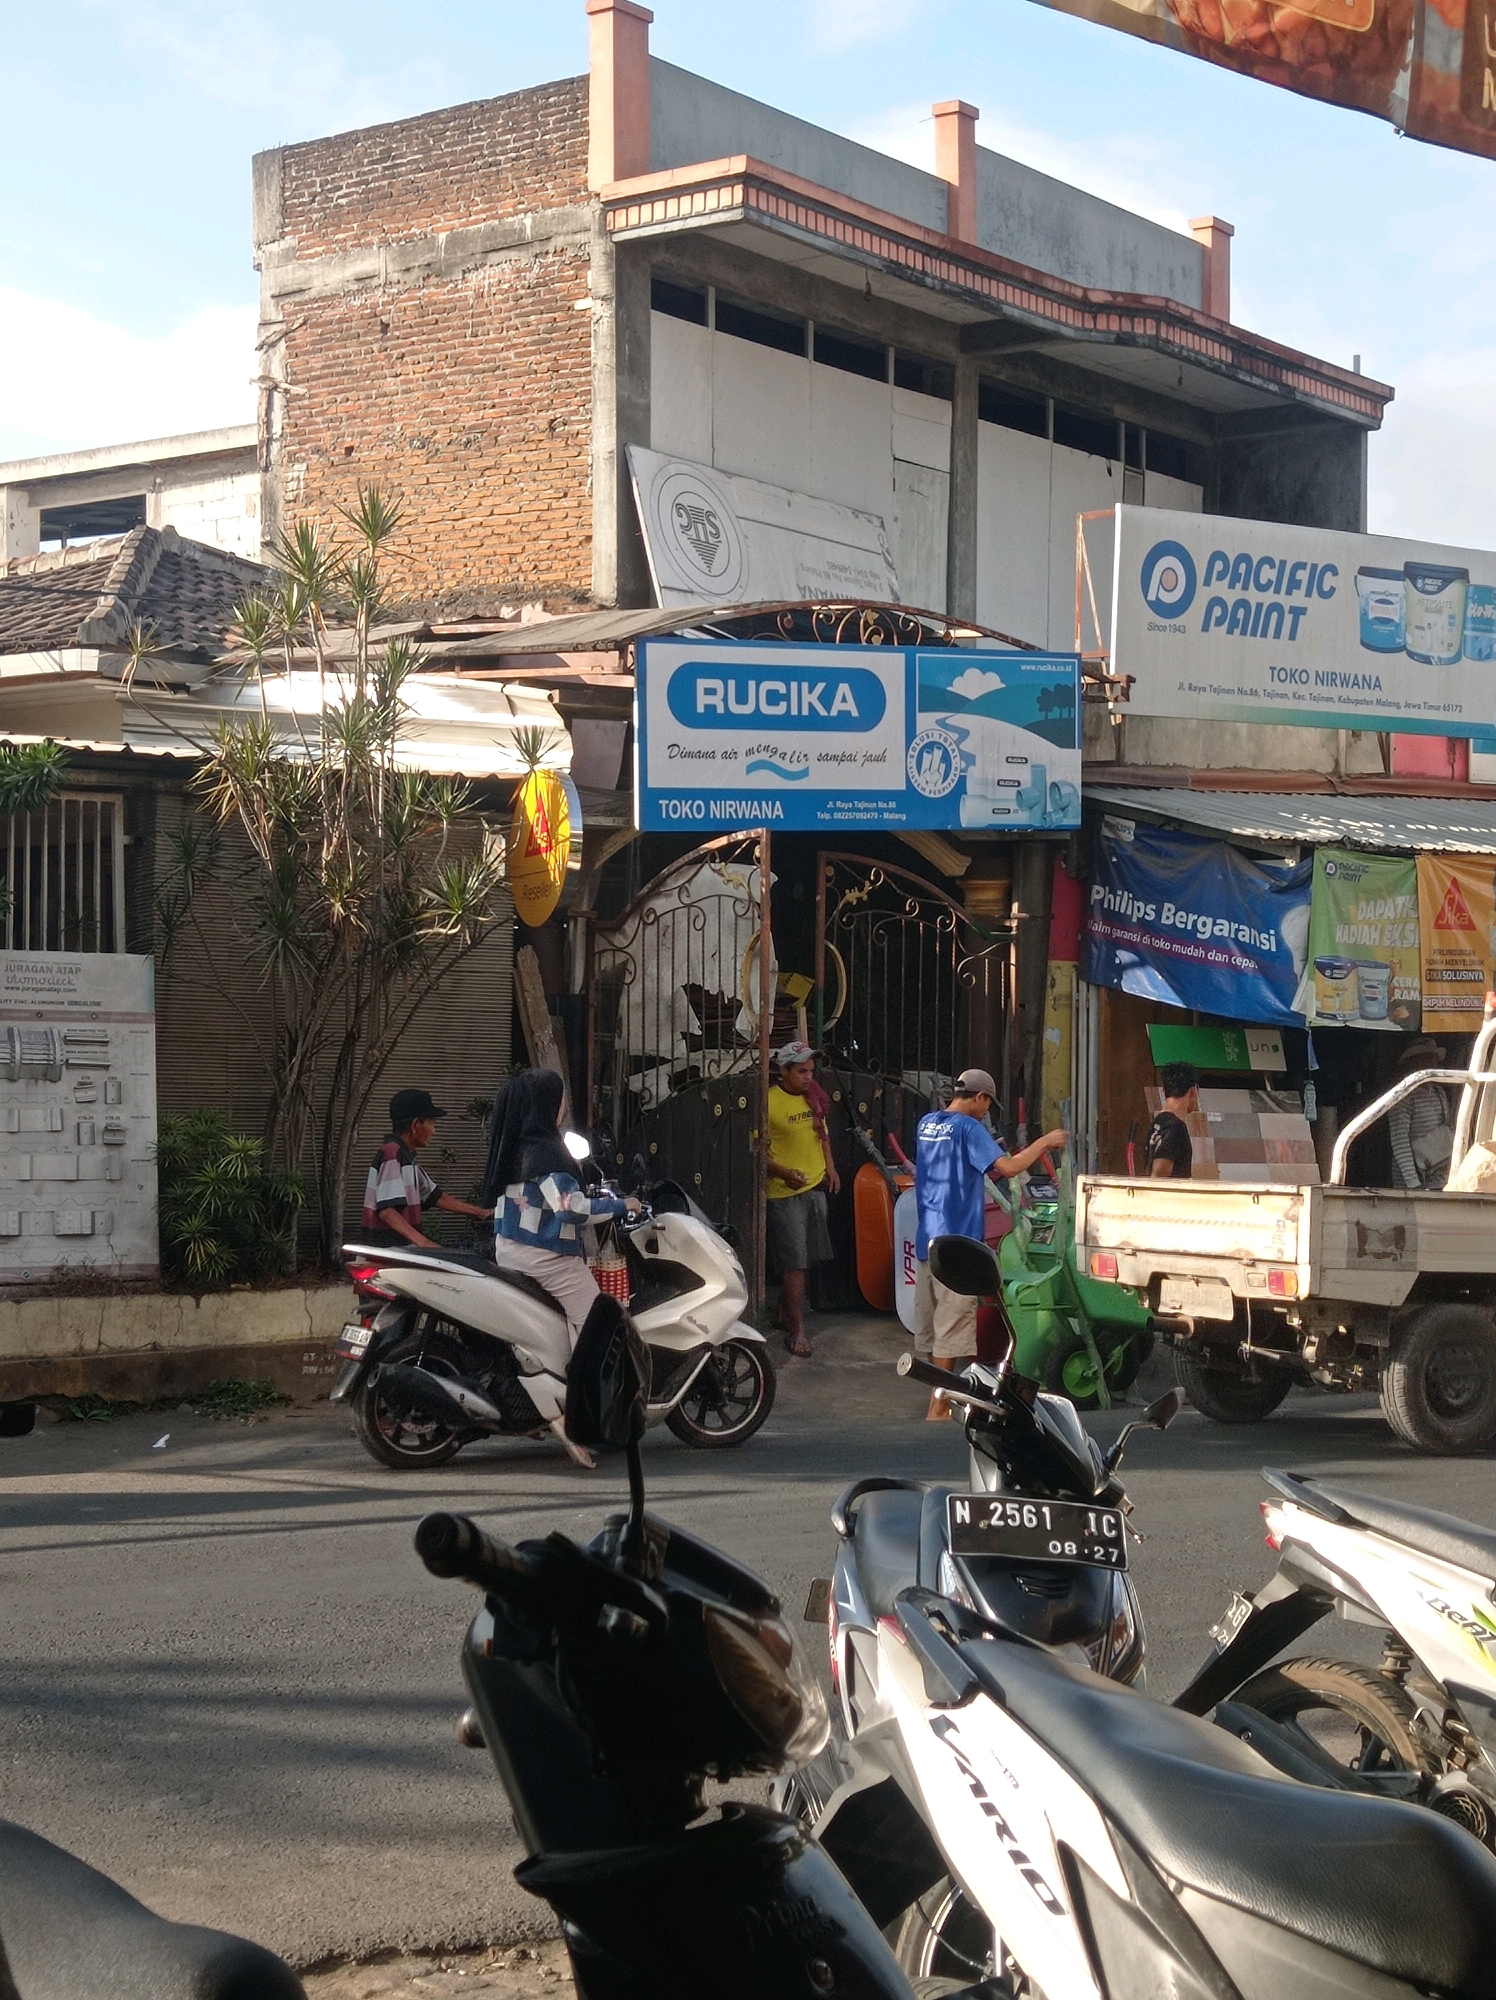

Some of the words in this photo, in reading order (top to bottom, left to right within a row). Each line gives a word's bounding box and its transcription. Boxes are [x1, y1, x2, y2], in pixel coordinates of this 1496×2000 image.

[1203, 550, 1339, 600] PACIFIC
[1147, 621, 1168, 633] Since
[1168, 623, 1186, 635] 1943
[1201, 598, 1308, 642] PAINT
[1020, 663, 1072, 672] www.rucika.co.id
[1268, 666, 1310, 685] TOKO
[1314, 670, 1383, 692] NIRWANA
[695, 677, 860, 718] RUCIKA
[1177, 682, 1186, 691] Jl.
[1188, 683, 1207, 694] Raya
[1209, 684, 1235, 695] Tajinan
[1403, 700, 1422, 711] Jawa
[1442, 703, 1463, 713] 65172
[667, 743, 717, 760] Dimana
[720, 749, 738, 760] air
[745, 743, 810, 764] mengalir
[816, 750, 858, 767] sampai
[861, 748, 888, 767] jauh
[909, 731, 934, 759] SOLUSI
[937, 732, 958, 760] TOTAL
[659, 799, 705, 819] TOKO
[710, 800, 784, 819] NIRWANA
[1338, 862, 1370, 874] PACIFIC
[1338, 872, 1363, 883] PAINT
[522, 883, 553, 902] Reseller
[1090, 885, 1157, 922] Philips
[1160, 902, 1277, 952] Bergaransi
[1437, 893, 1470, 925] Sika
[1112, 927, 1141, 942] garansi
[1142, 934, 1150, 945] di
[1152, 938, 1171, 950] toko
[1172, 944, 1205, 959] mudah
[1207, 949, 1229, 963] dan
[1336, 924, 1382, 946] HADIAH
[4, 964, 53, 974] JURAGAN
[56, 966, 82, 975] ATAP
[1442, 970, 1484, 980] SOLUSINYA
[903, 1240, 916, 1286] VPR
[955, 1500, 971, 1524] N
[989, 1501, 1052, 1531] 2561
[1087, 1511, 1119, 1539] IC
[928, 1714, 1067, 1916] VARIO
